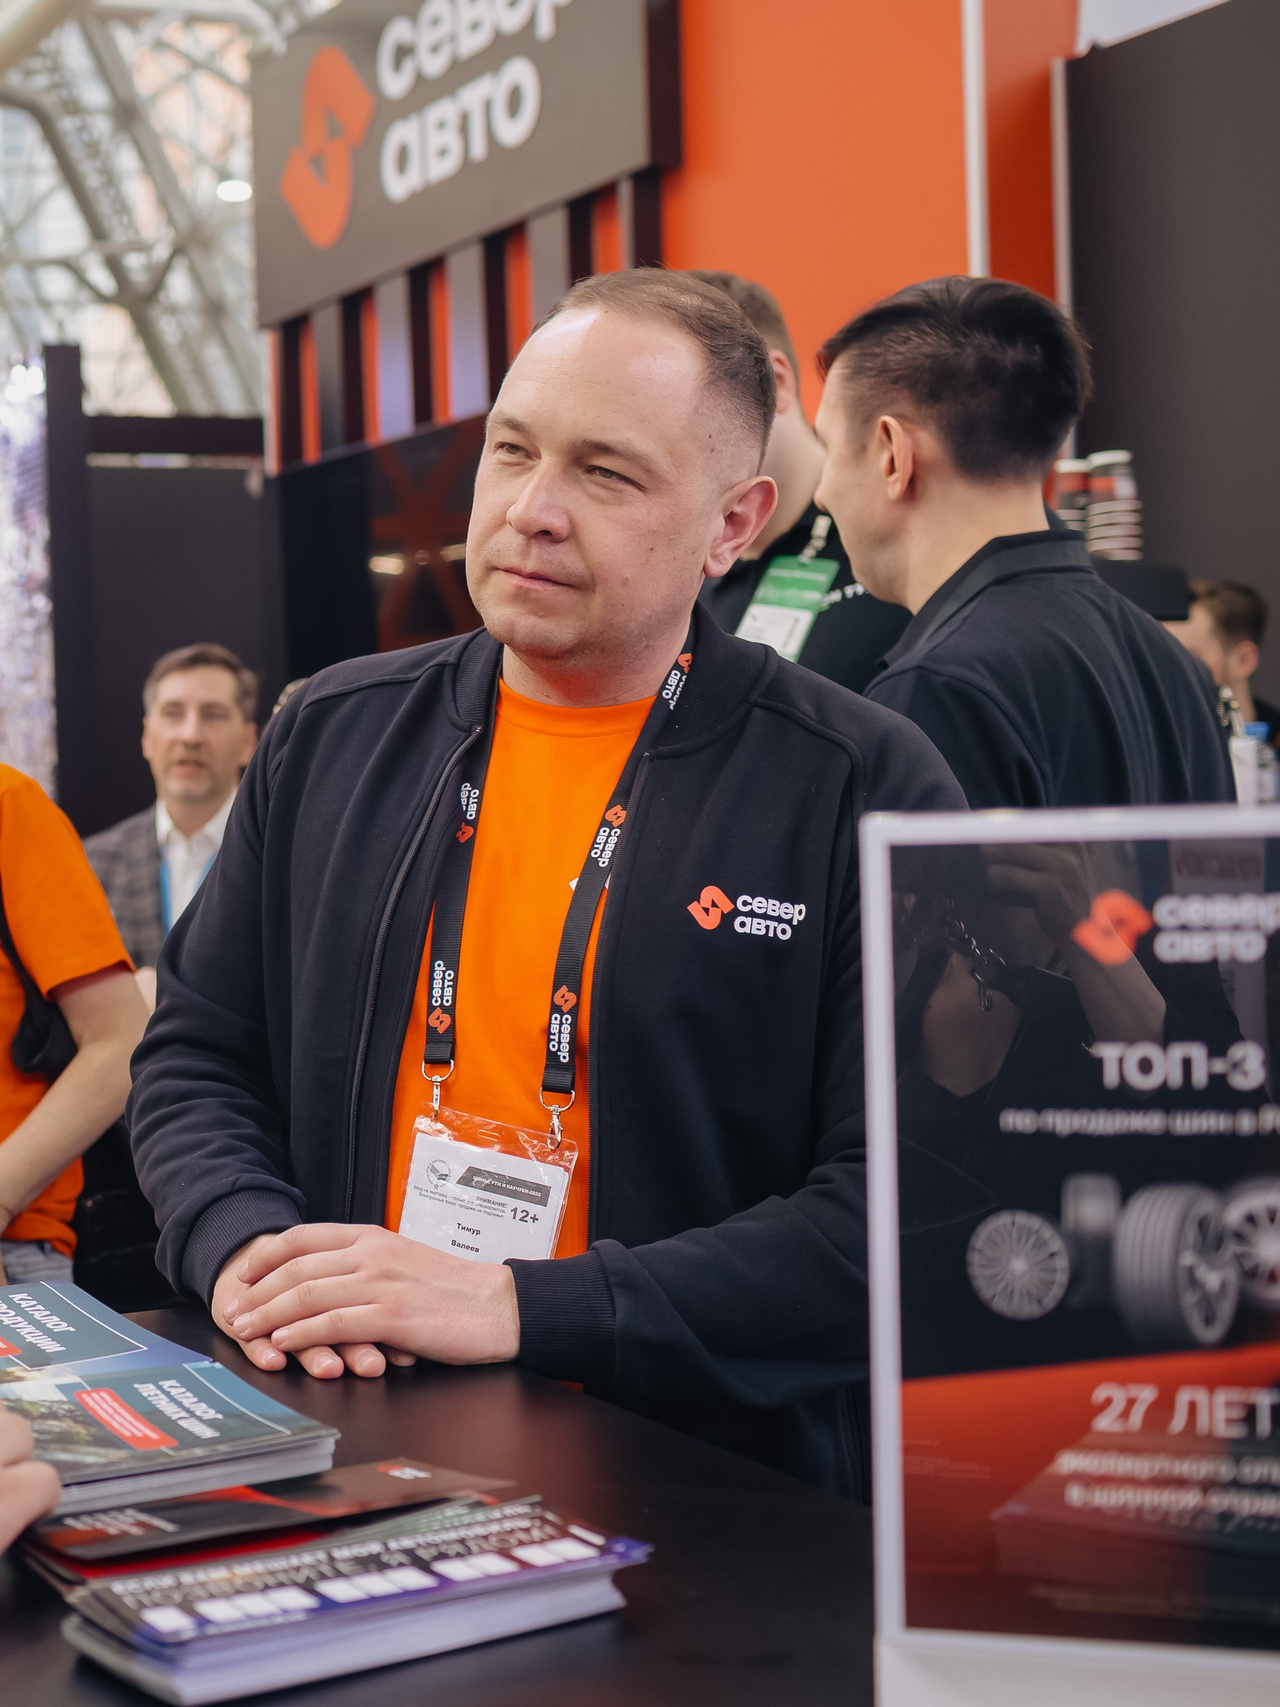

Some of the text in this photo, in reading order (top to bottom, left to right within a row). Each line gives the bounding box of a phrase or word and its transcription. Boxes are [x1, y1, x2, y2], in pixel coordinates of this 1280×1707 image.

[380, 55, 541, 202] авто
[661, 669, 682, 700] авто
[466, 788, 480, 820] авто
[590, 826, 610, 859] авто
[597, 827, 621, 868] север
[733, 915, 792, 941] авто
[736, 894, 807, 925] север
[431, 960, 445, 1007] север
[442, 969, 455, 1007] авто
[549, 1012, 561, 1052] авто
[557, 1013, 572, 1063] север
[1094, 1041, 1266, 1092] ТОП-3
[456, 1223, 482, 1236] Тимур
[510, 1207, 539, 1224] 12+
[451, 1239, 480, 1253] Валеев
[8, 1292, 77, 1333] КАТАЛОГ
[158, 1379, 223, 1420] КАТАЛОГ
[1091, 1382, 1280, 1439] 27 ЛЕТ
